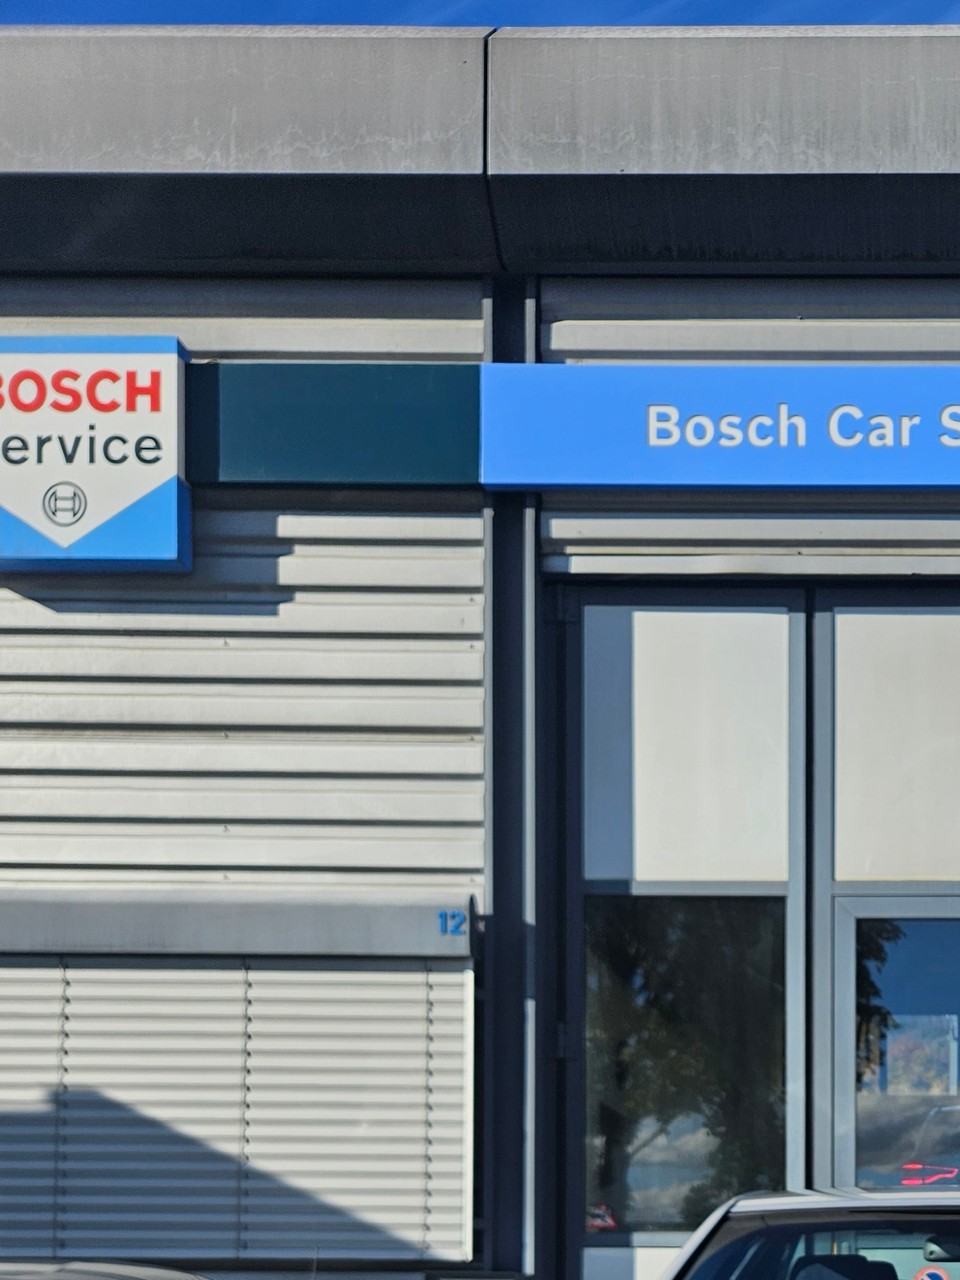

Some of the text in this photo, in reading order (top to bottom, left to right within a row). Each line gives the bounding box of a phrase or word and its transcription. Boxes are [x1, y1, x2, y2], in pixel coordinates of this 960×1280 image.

[0, 370, 161, 412] OSCH
[646, 402, 806, 447] Bosch
[828, 404, 920, 447] Car
[439, 910, 466, 936] 12
